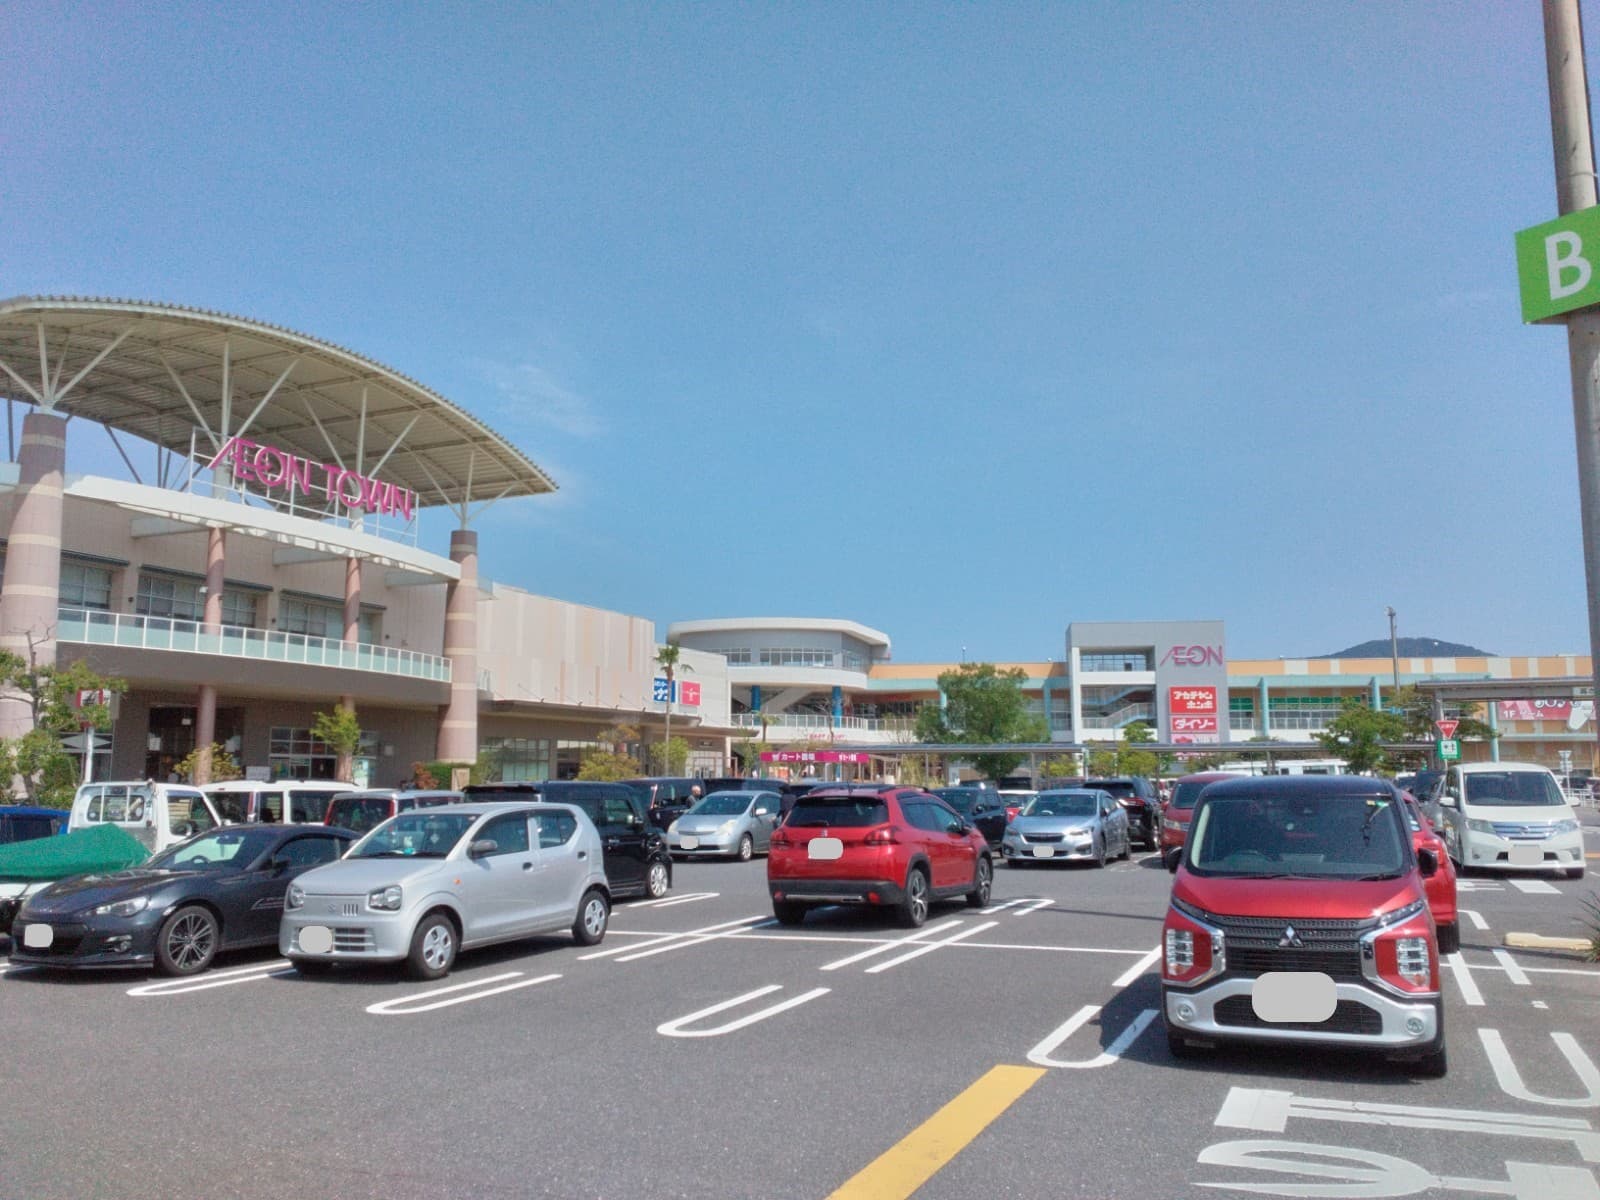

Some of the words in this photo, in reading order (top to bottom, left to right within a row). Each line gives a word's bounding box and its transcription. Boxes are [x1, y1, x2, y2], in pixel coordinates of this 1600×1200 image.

[1545, 231, 1592, 301] B
[321, 464, 413, 521] TOWN
[1173, 691, 1213, 700] アカチャン
[1175, 718, 1214, 730] ダイソー
